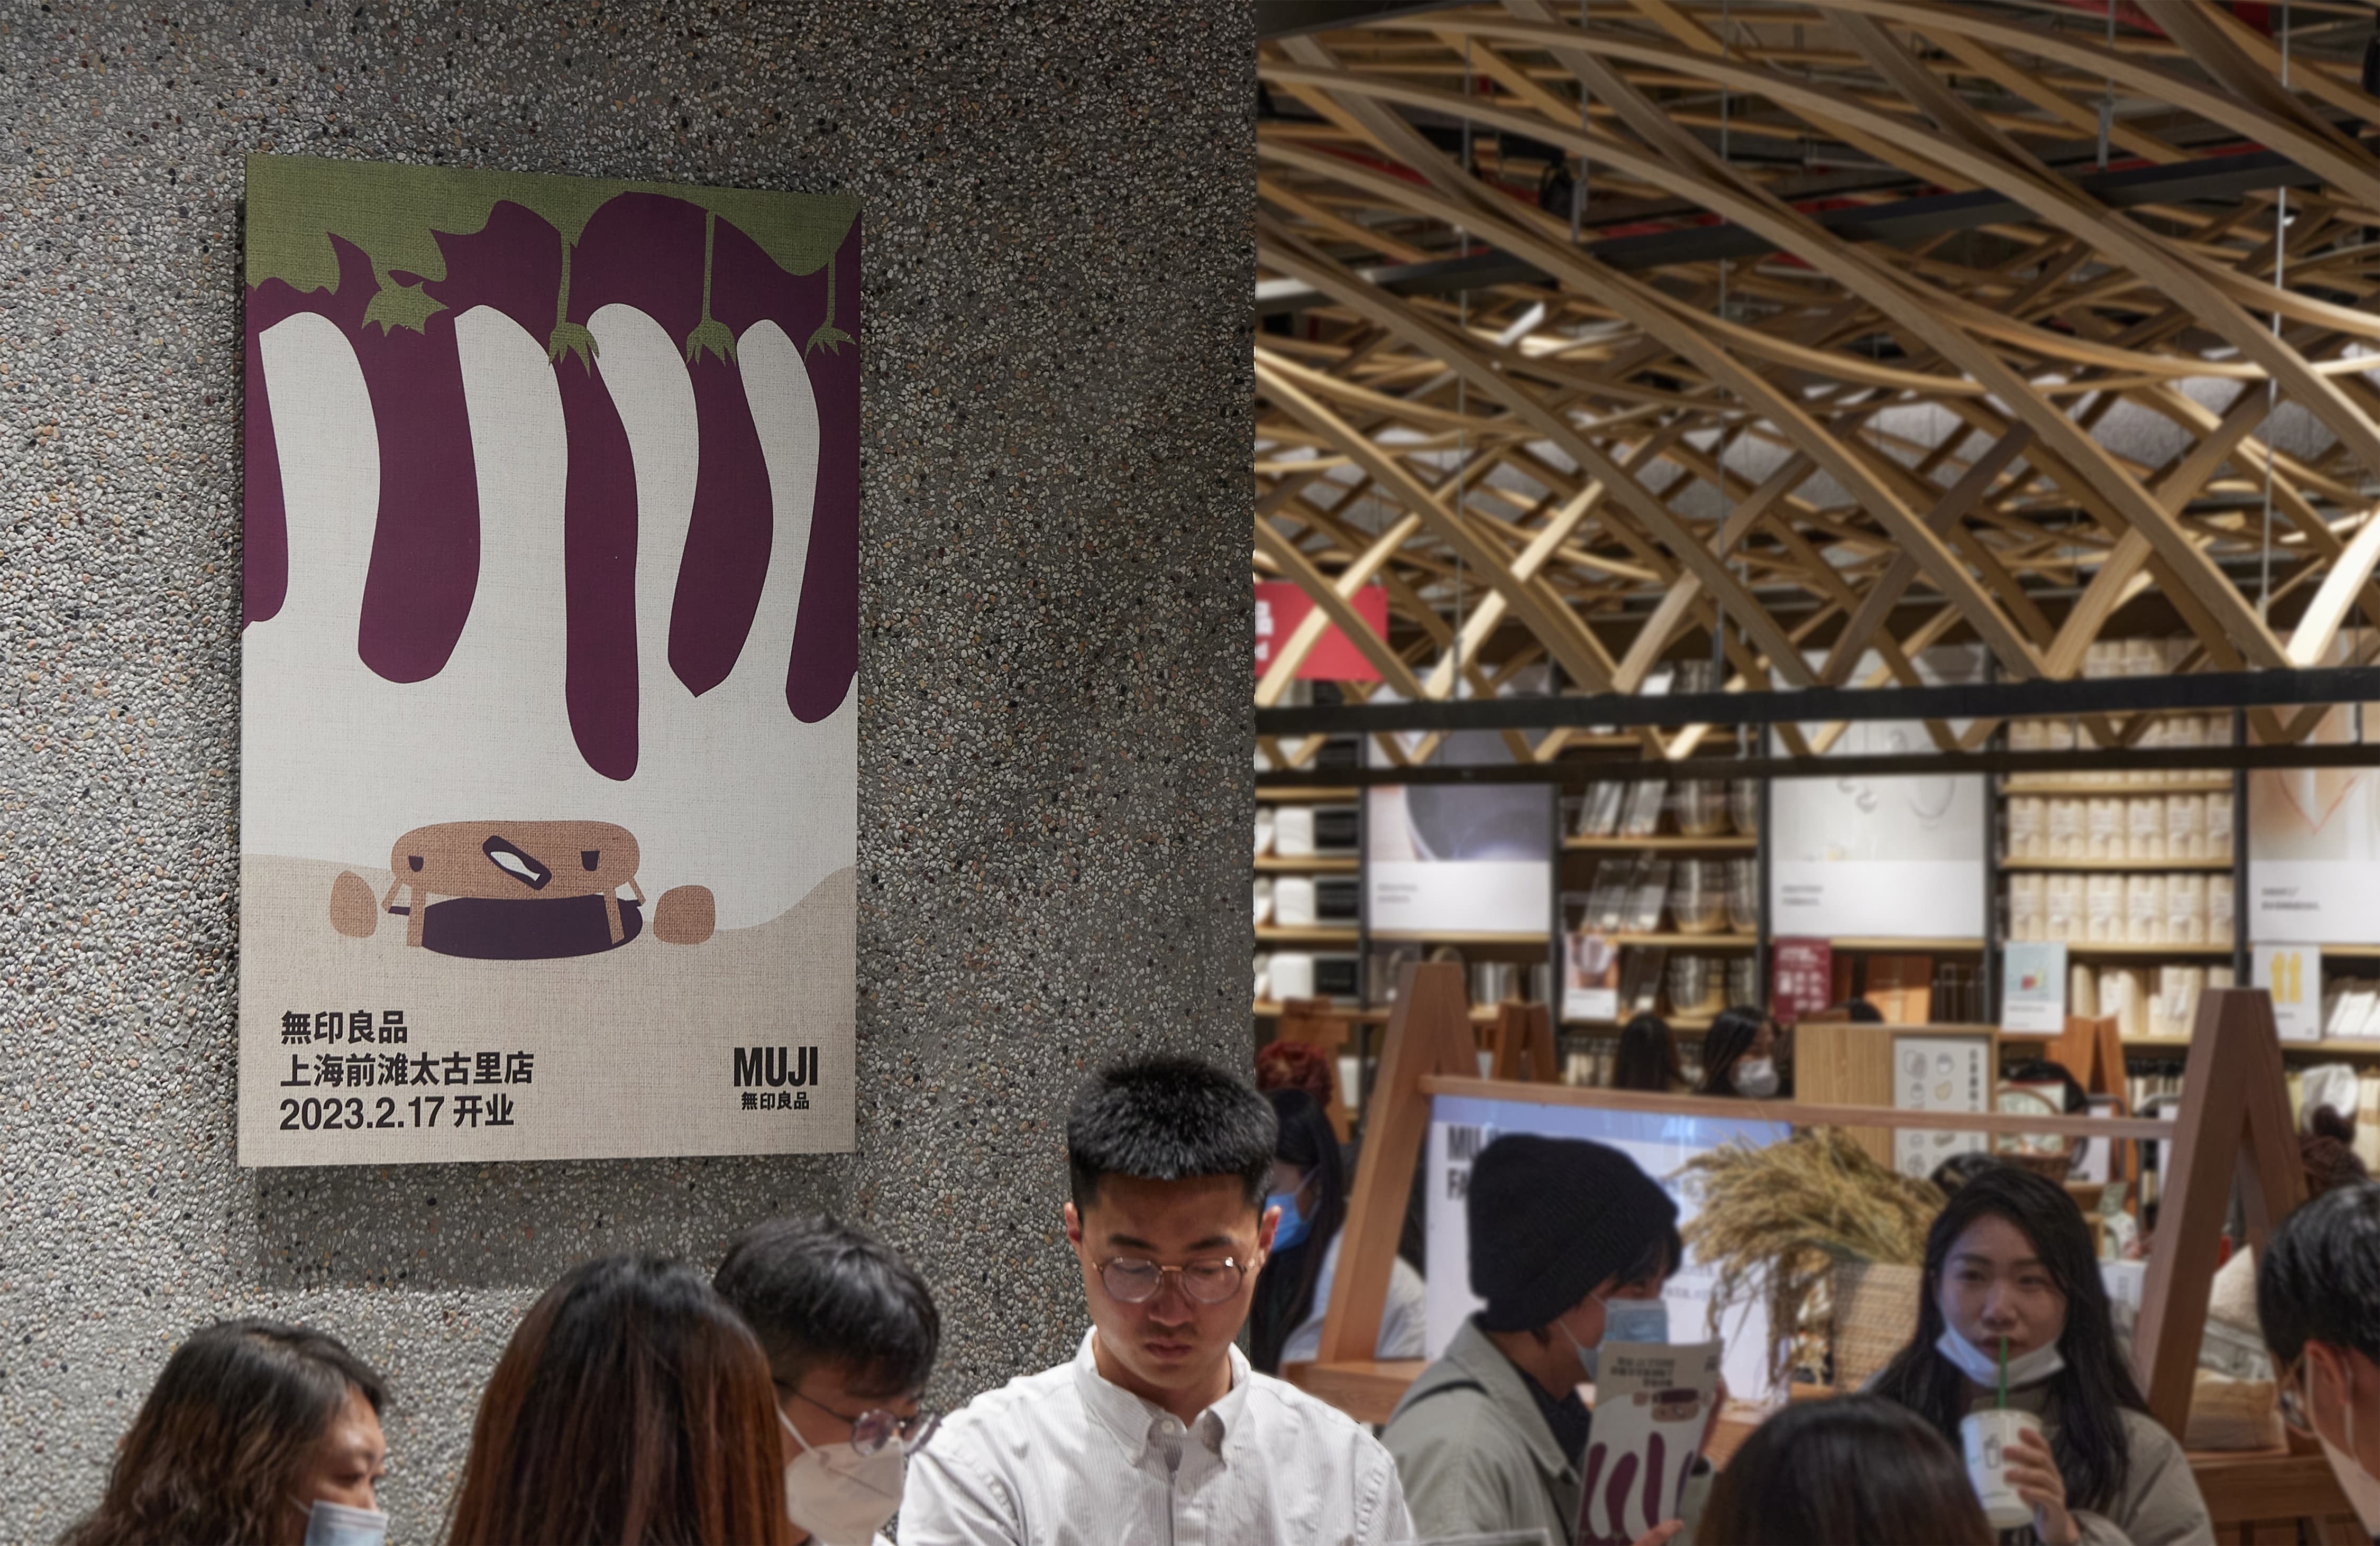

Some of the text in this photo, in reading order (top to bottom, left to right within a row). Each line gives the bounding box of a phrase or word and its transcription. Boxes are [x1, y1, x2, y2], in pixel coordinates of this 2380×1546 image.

[281, 1010, 408, 1044] 無印良品
[280, 1051, 534, 1087] 上海前滩太古里店
[734, 1046, 818, 1087] MUJI
[280, 1093, 514, 1130] 2023.2.17 开业
[741, 1091, 810, 1111] 無印良品
